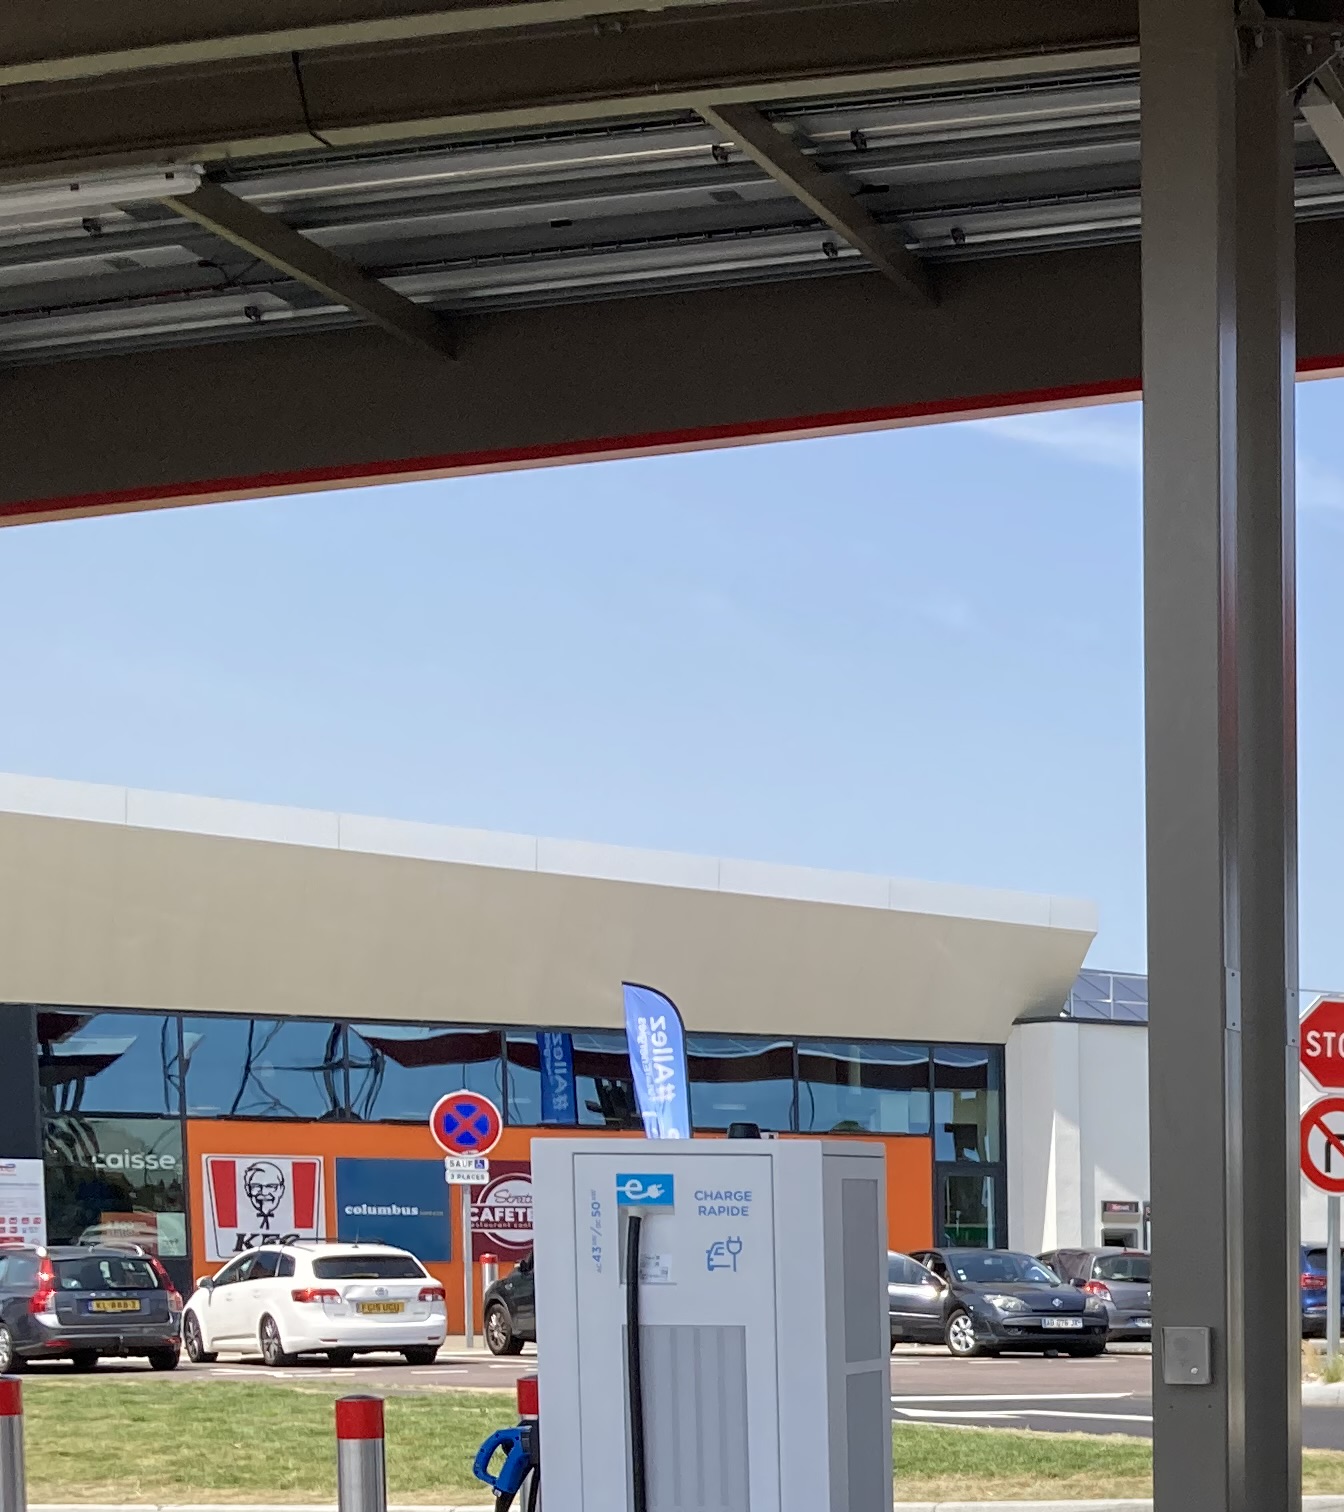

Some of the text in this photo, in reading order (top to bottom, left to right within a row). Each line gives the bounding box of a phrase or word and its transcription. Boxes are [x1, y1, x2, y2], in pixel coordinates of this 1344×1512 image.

[92, 1149, 176, 1170] caisse
[449, 1160, 473, 1168] SAUF
[694, 1190, 752, 1202] CHARGE
[344, 1203, 419, 1216] columbus
[698, 1205, 749, 1217] RAPIDE
[232, 1233, 300, 1252] KFC
